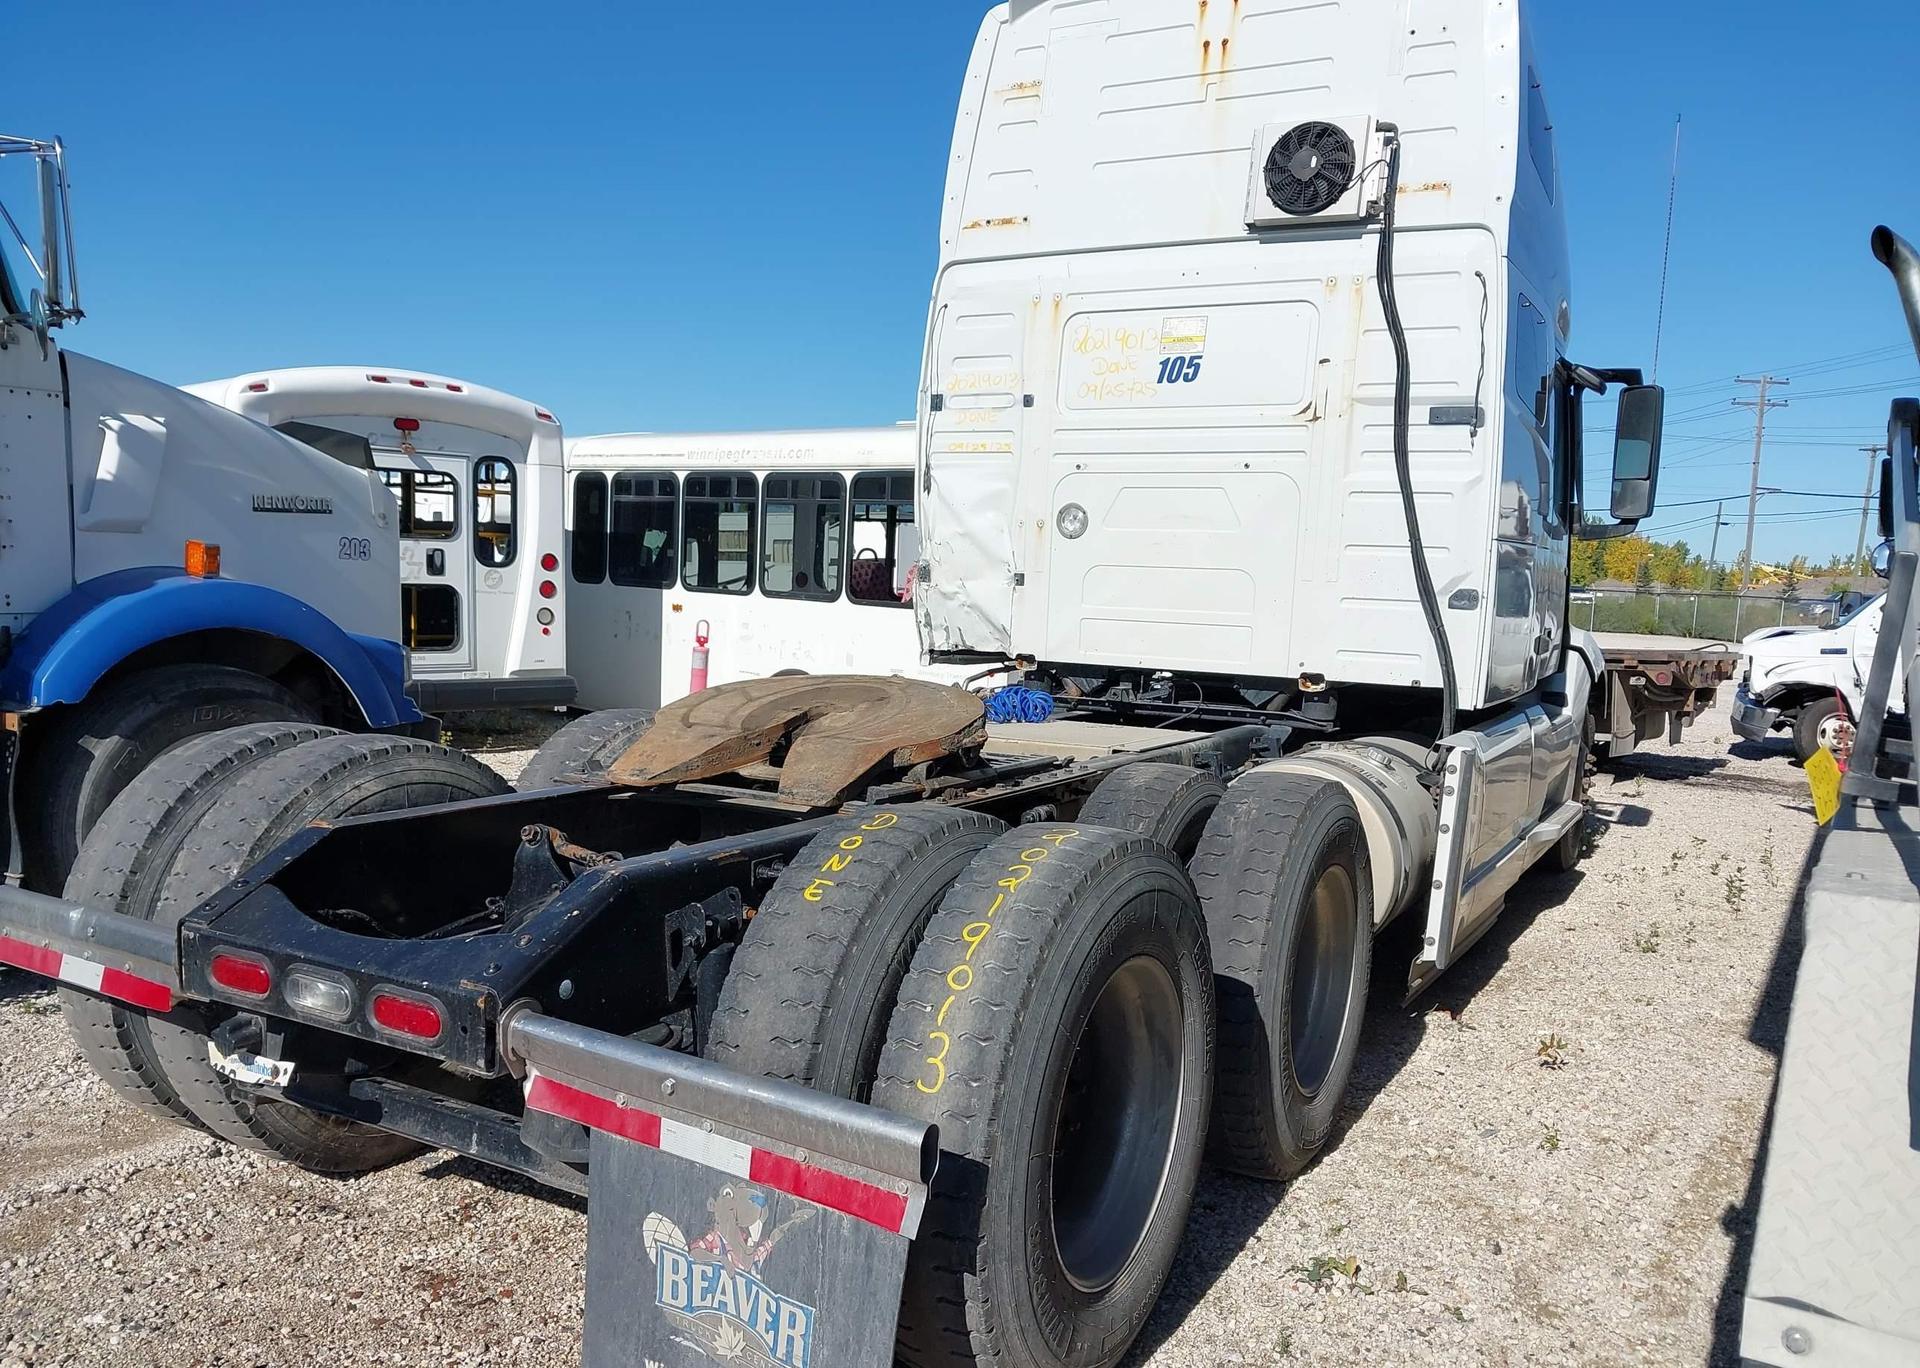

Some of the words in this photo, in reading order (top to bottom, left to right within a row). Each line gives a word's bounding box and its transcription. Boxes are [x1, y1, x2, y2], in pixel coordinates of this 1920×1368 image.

[1156, 355, 1203, 384] 105
[252, 494, 333, 514] KENWORTH
[338, 536, 371, 561] 203
[803, 813, 898, 902] DONE
[916, 829, 1079, 1094] 20219013
[661, 1250, 808, 1368] BEAVER
